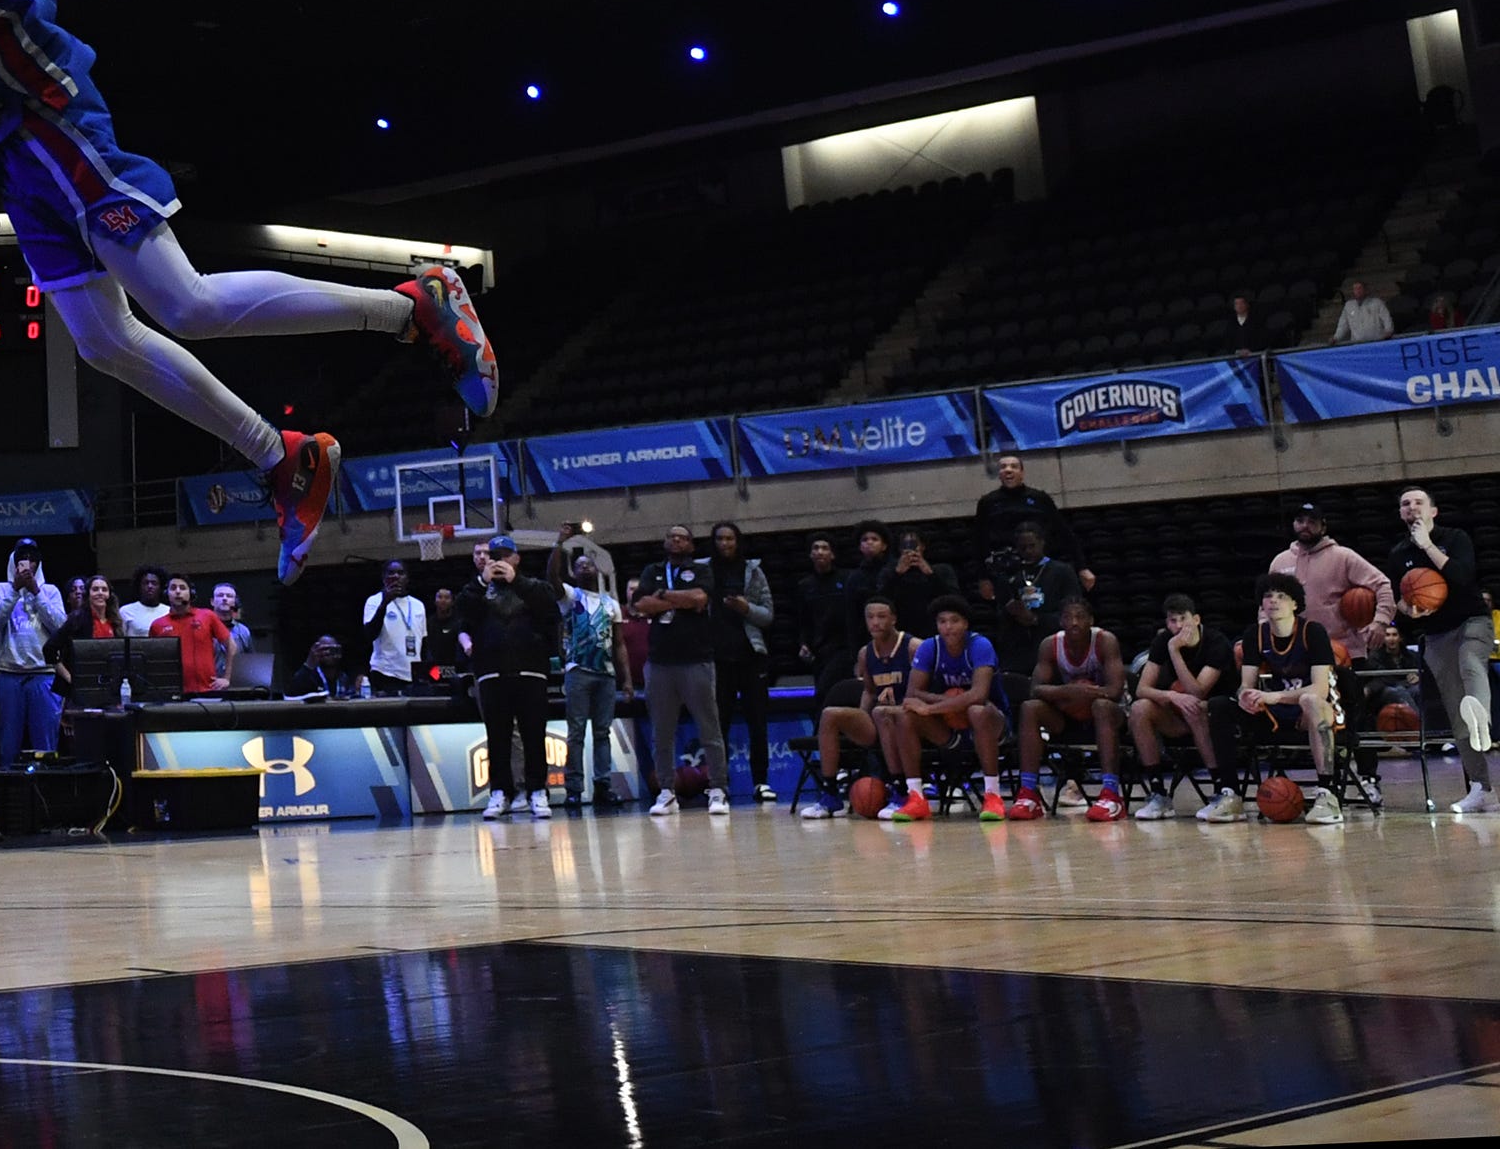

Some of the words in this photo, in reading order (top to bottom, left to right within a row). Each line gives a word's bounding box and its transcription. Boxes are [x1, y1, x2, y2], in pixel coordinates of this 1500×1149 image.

[27, 321, 40, 339] 0
[1400, 334, 1484, 370] RISE
[1060, 384, 1179, 430] GOVERNORS
[571, 452, 622, 468] UNDER
[626, 445, 697, 463] ARMOUR
[276, 804, 330, 817] ARMOUR
